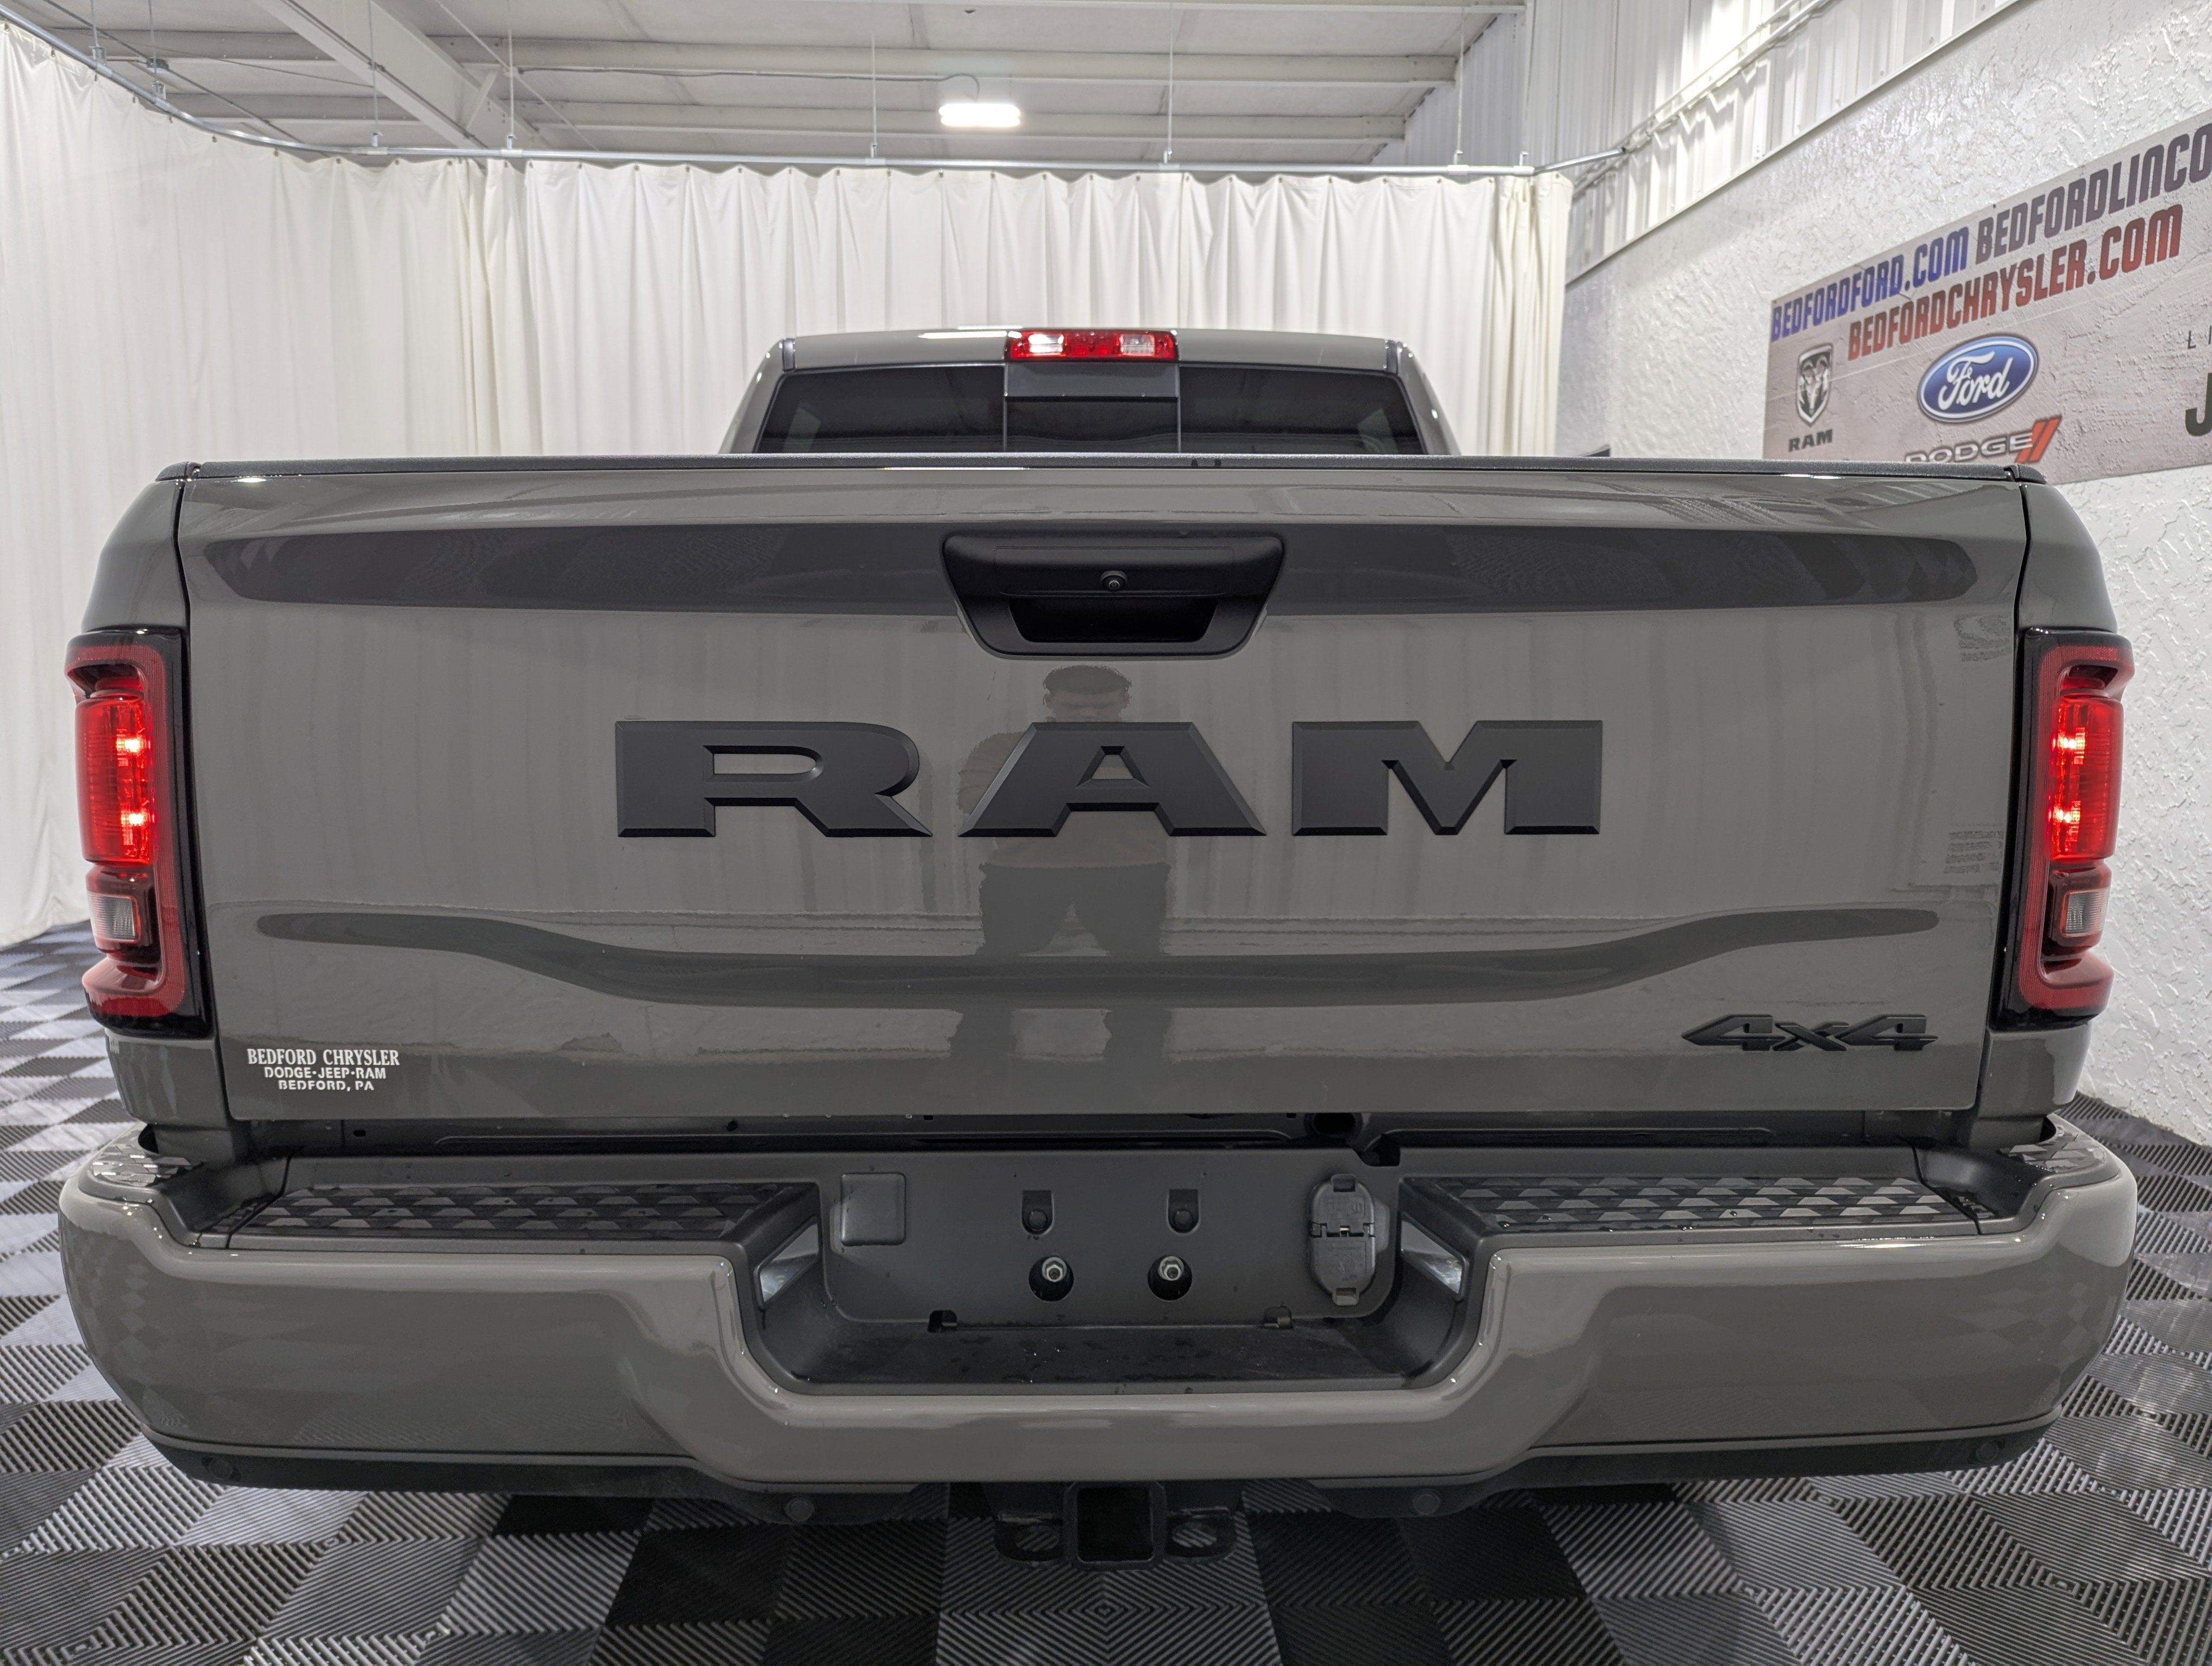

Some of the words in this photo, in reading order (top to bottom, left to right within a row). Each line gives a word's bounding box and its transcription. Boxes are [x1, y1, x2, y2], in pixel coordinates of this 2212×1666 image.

[1771, 227, 1969, 342] BEDFORDFORD.COM
[1848, 204, 2183, 361] BEDFORDCHRYSLER.COM
[1938, 351, 2014, 411] Ford
[1789, 429, 1833, 452] RAM
[616, 721, 1603, 837] RAM
[247, 1048, 317, 1065] BEDFORD
[323, 1049, 400, 1066] CHRYSLER
[1681, 1014, 1939, 1052] 4x4
[278, 1080, 351, 1092] BEDFORD,
[355, 1081, 375, 1091] PA
